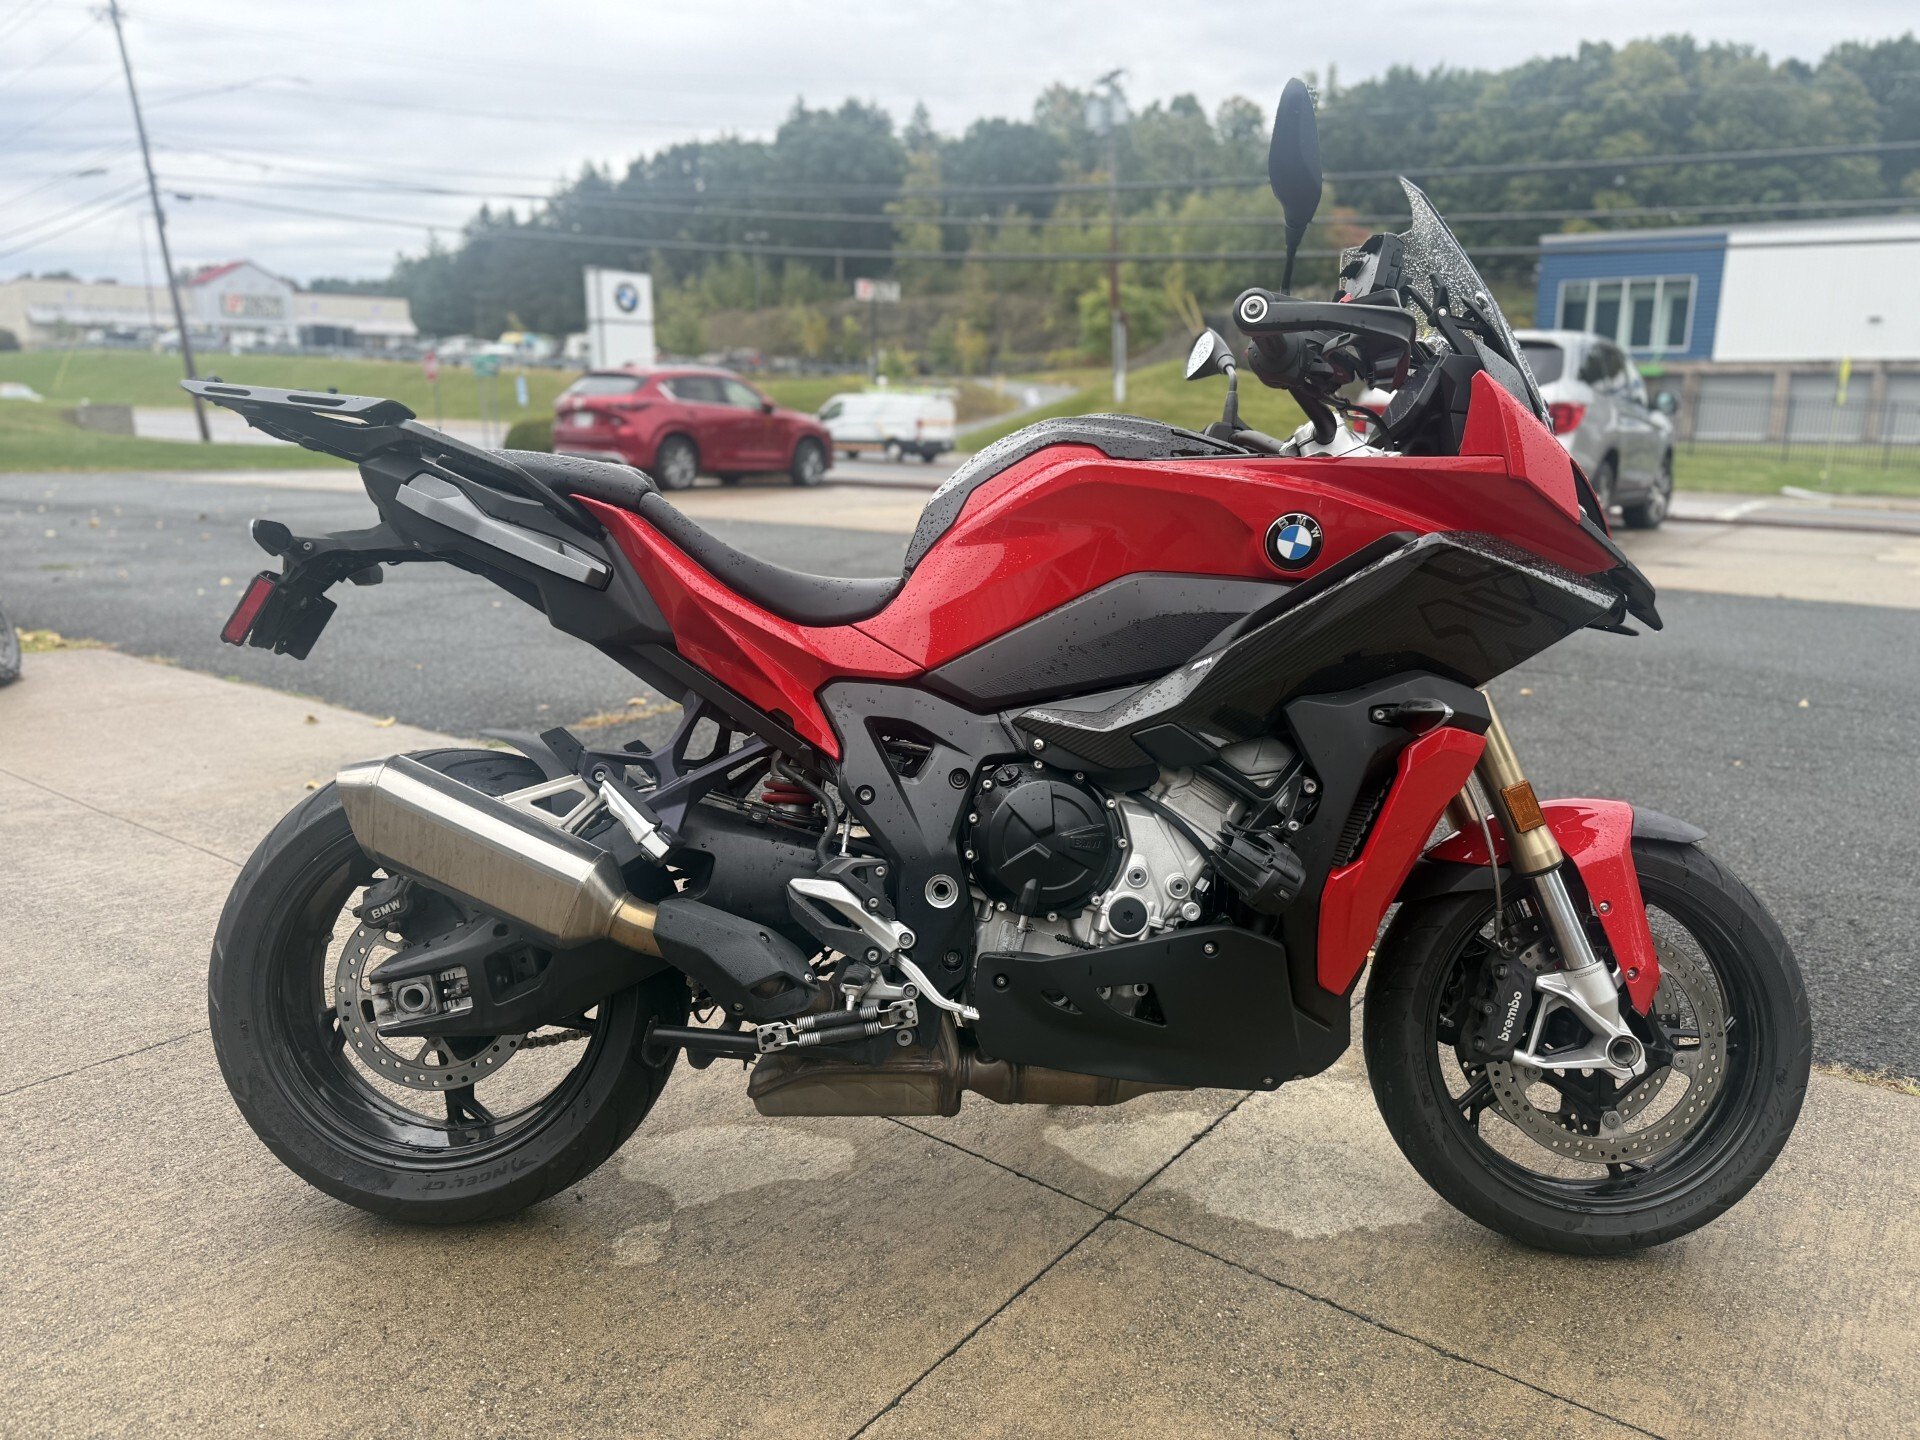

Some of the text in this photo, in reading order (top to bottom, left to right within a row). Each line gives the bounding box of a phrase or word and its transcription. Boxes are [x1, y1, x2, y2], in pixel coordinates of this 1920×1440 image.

[1277, 515, 1320, 538] BMW
[371, 899, 400, 919] BMW
[1497, 991, 1522, 1041] brembo
